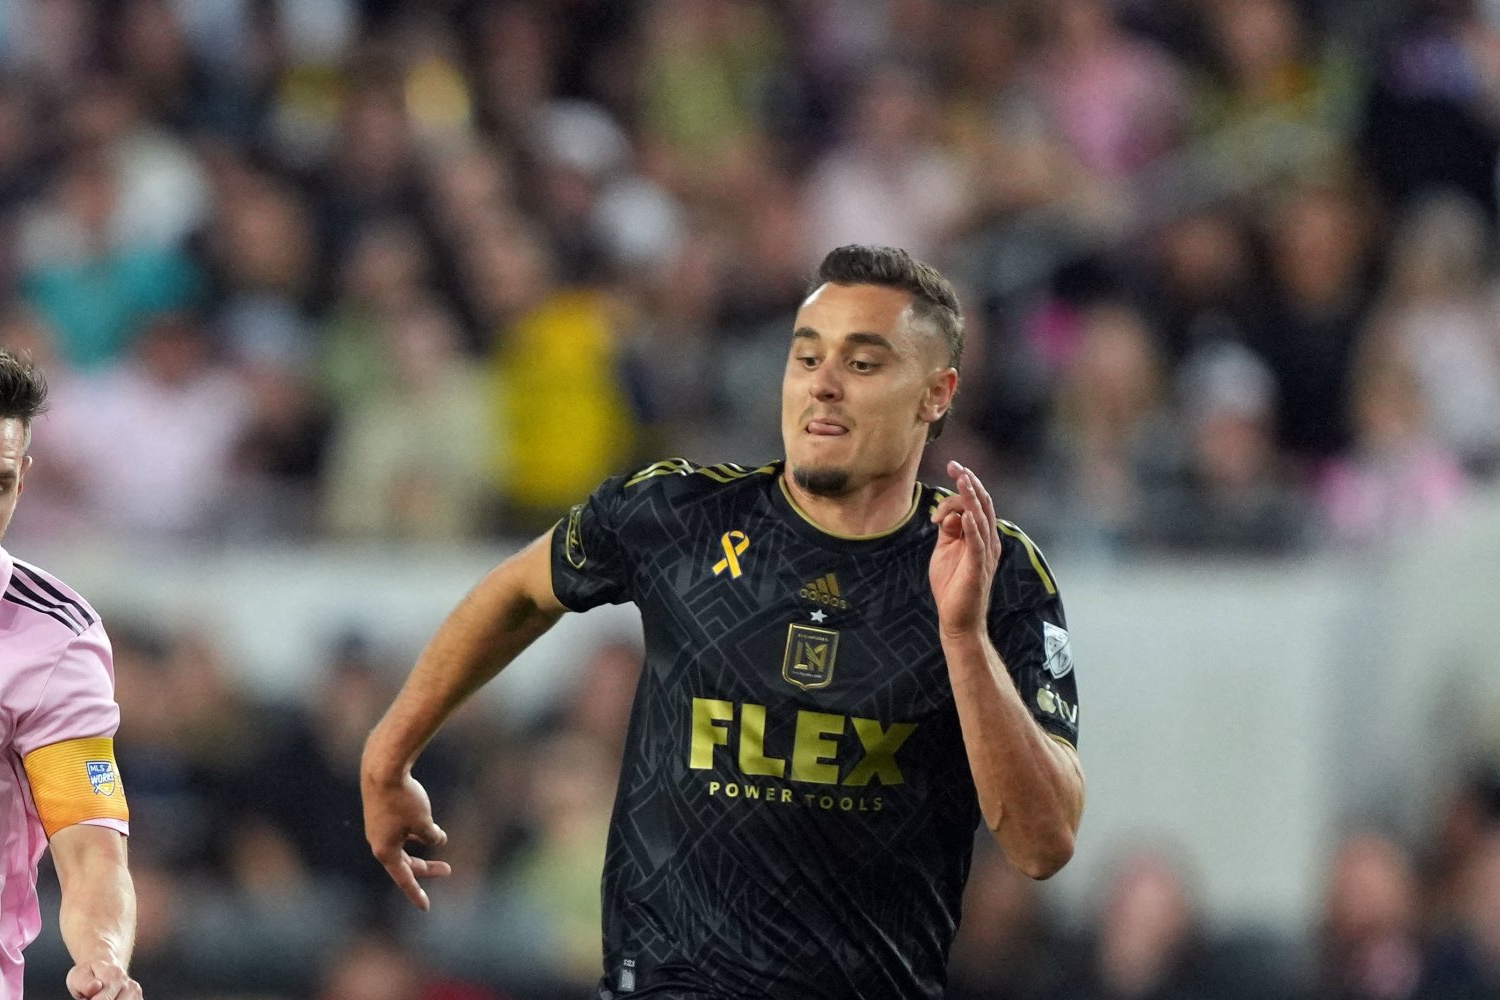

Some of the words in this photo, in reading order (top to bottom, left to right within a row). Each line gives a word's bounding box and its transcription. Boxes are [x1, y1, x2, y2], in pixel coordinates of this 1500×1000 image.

[800, 586, 847, 609] adidas
[689, 697, 918, 786] FLEX
[89, 764, 105, 772] MLS
[709, 781, 793, 803] POWER
[805, 794, 883, 811] TOOLS
